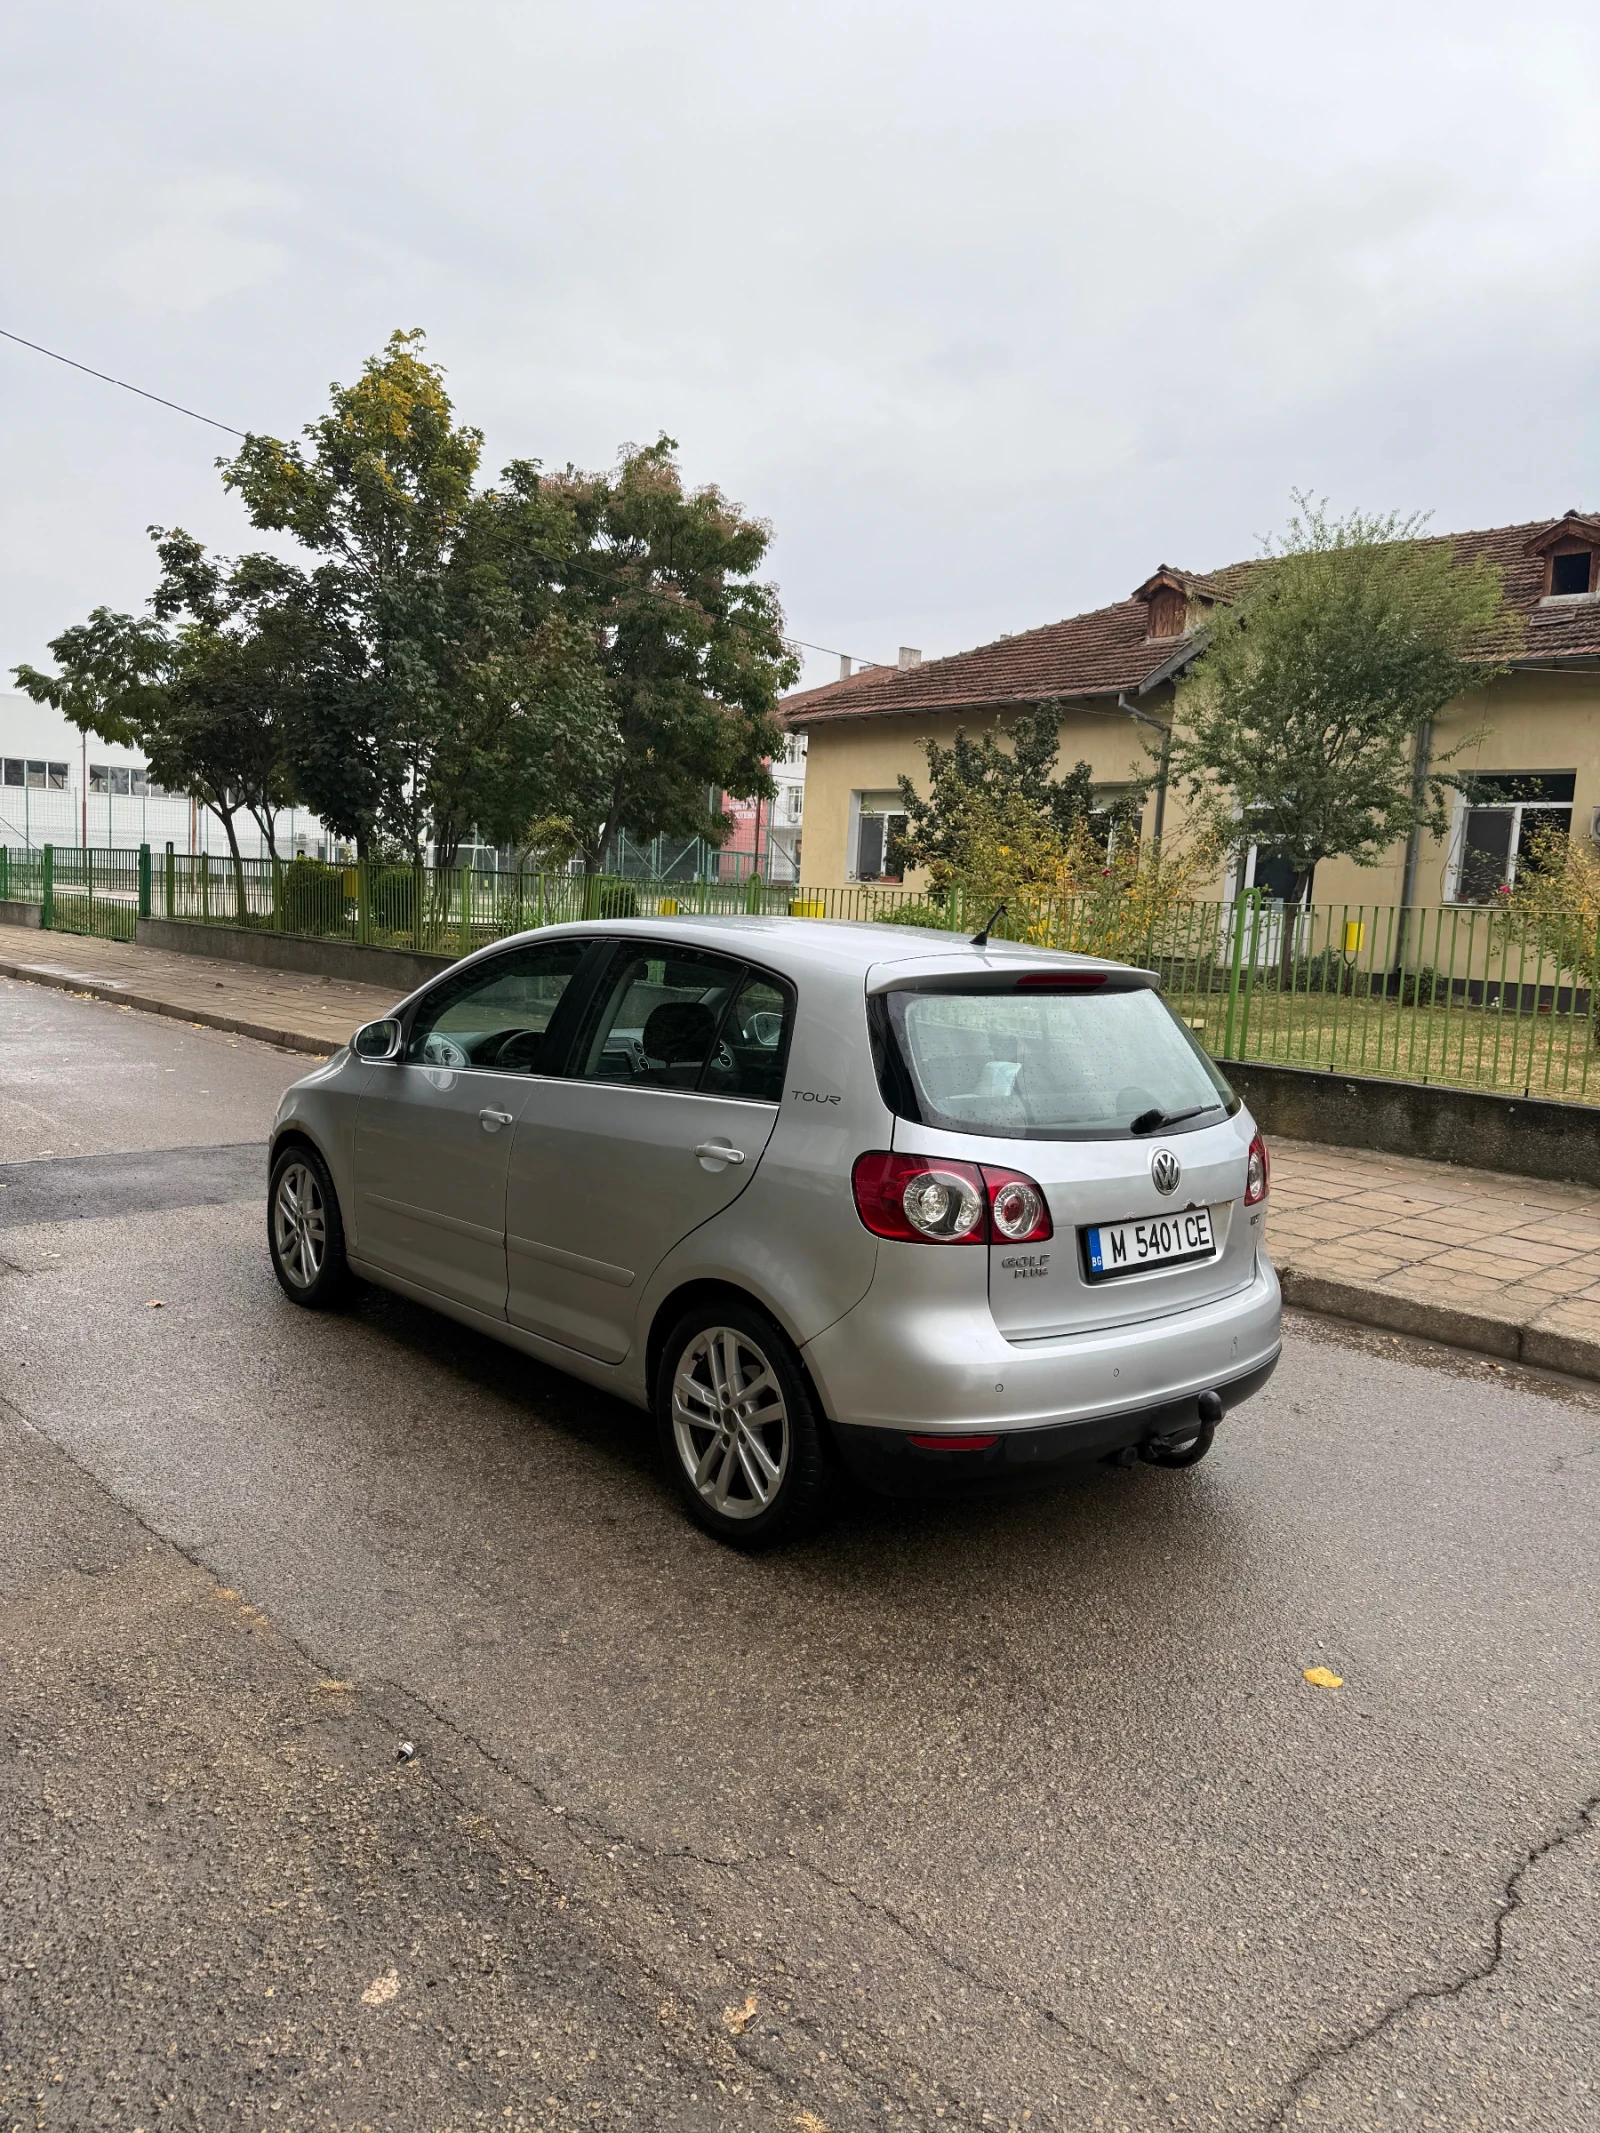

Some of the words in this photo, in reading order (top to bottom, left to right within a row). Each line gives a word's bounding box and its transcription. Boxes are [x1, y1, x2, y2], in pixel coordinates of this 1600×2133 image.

[791, 1090, 842, 1106] TOUR
[1110, 1229, 1127, 1263] M
[1002, 1253, 1051, 1268] GOLF
[1091, 1256, 1102, 1267] BG
[1013, 1266, 1049, 1279] PLUS
